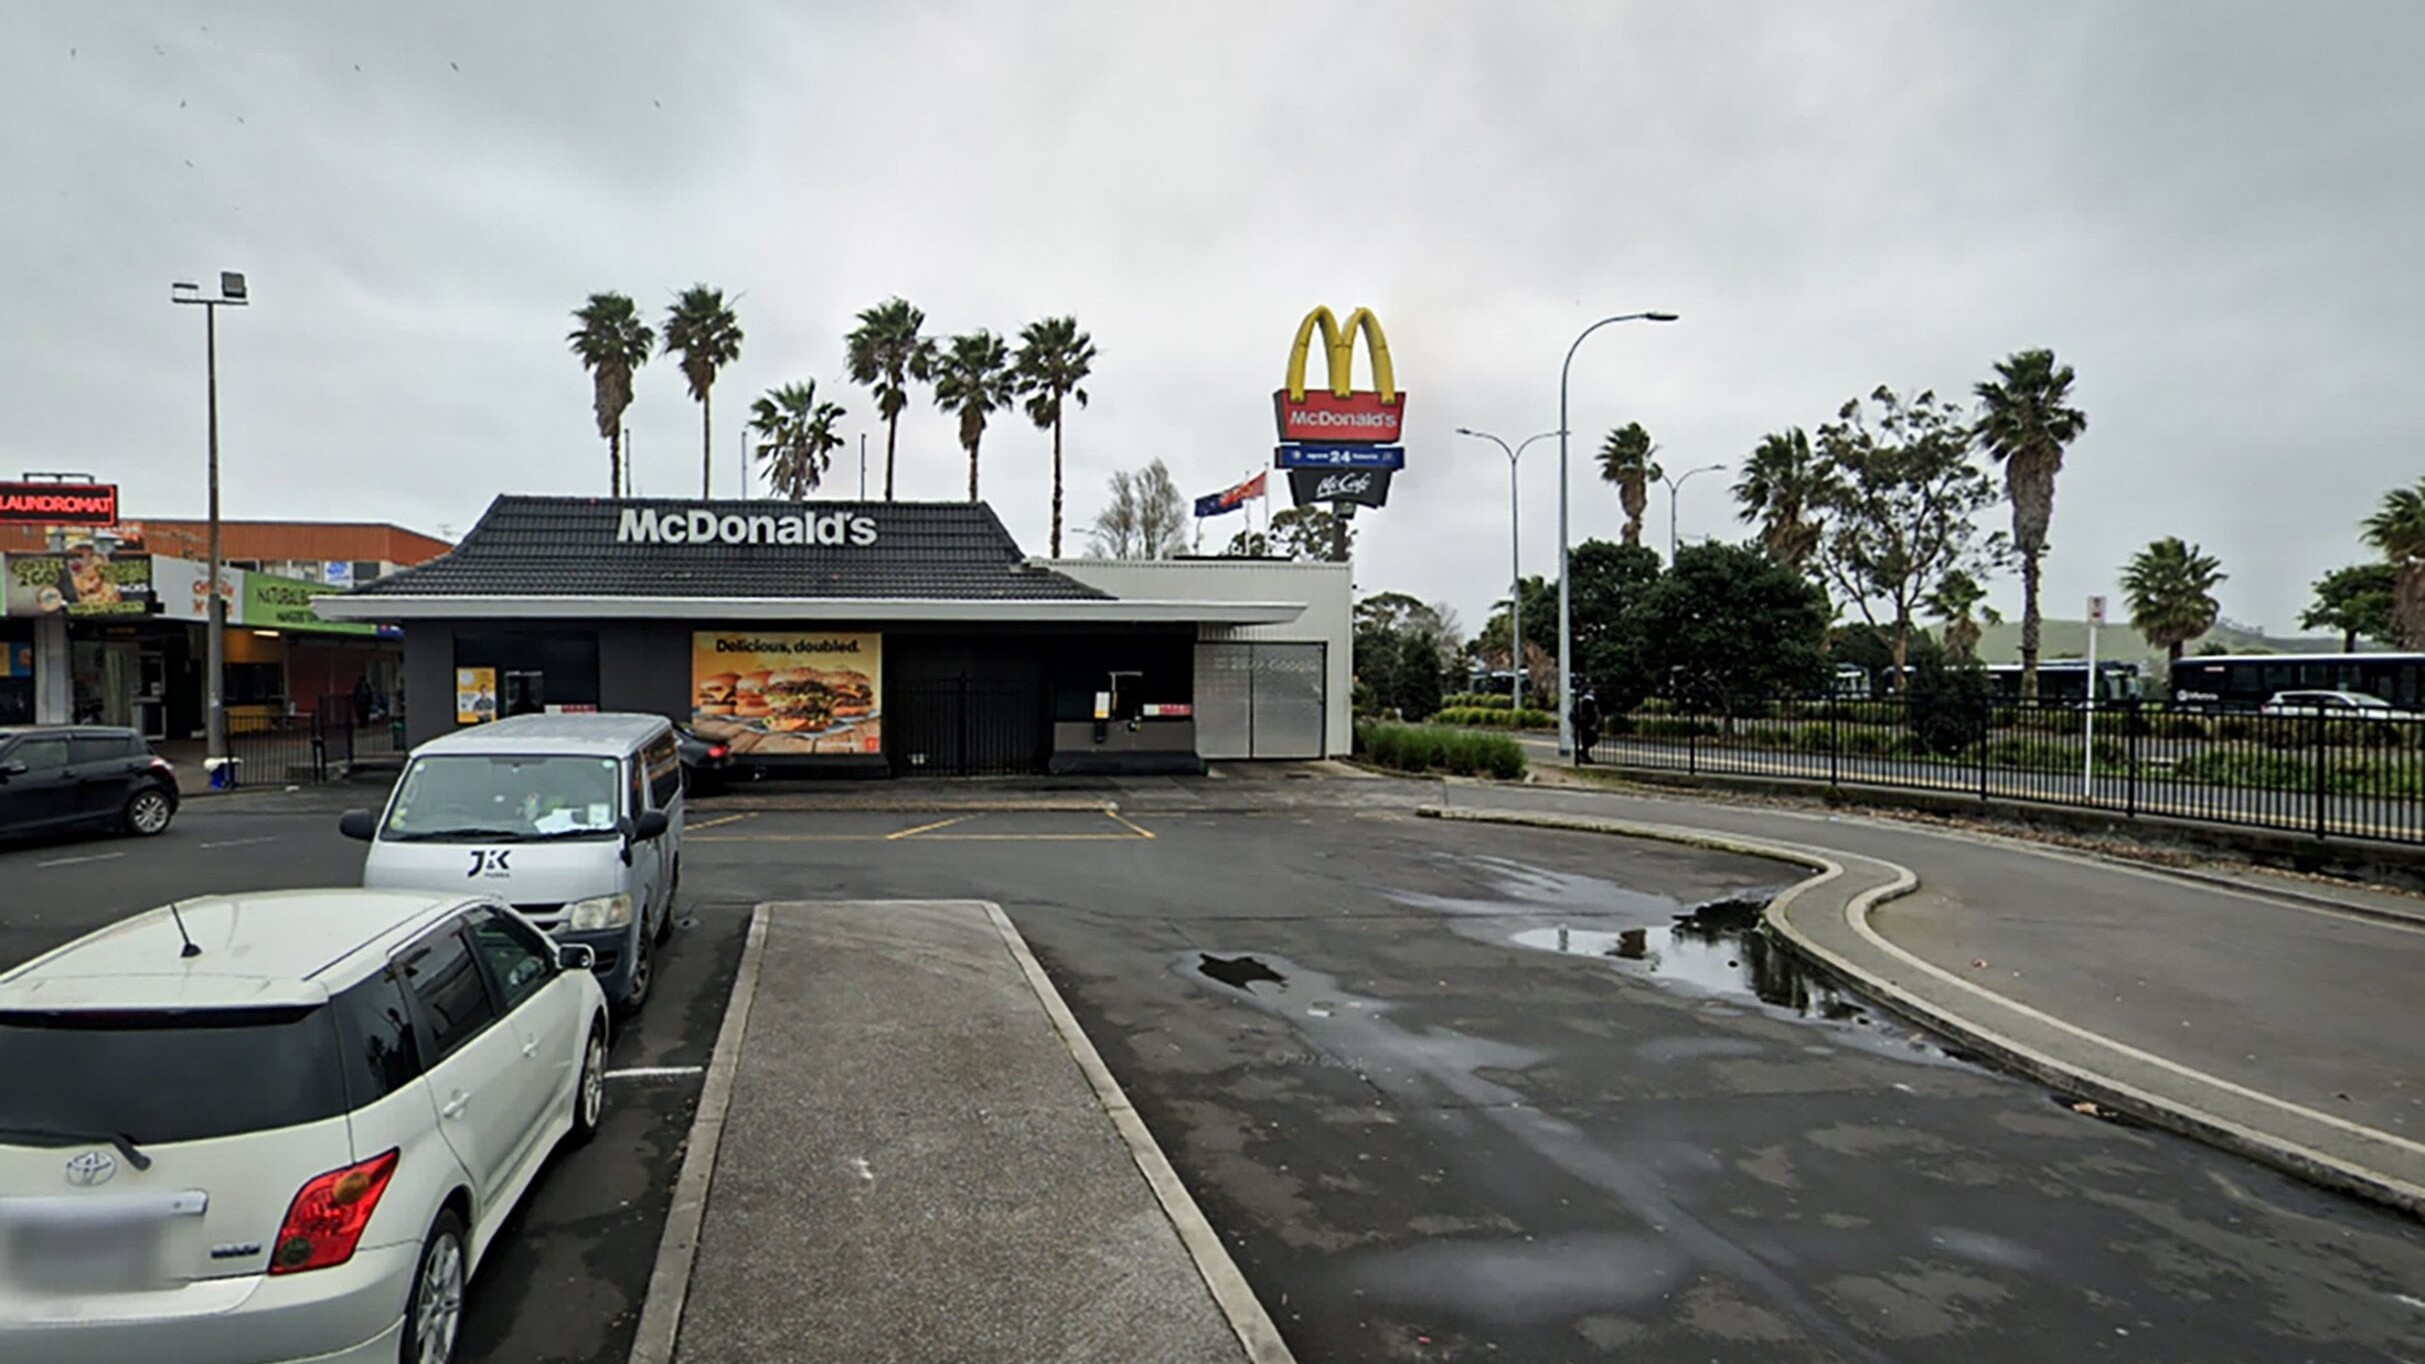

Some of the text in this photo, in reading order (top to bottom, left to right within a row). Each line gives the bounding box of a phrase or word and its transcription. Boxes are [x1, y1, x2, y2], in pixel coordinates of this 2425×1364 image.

[1291, 411, 1396, 427] McDonald's
[1330, 450, 1351, 462] 24
[0, 496, 111, 512] LAUNDROMAT
[617, 508, 878, 545] McDonald's
[716, 639, 860, 653] Delicious, doubled.
